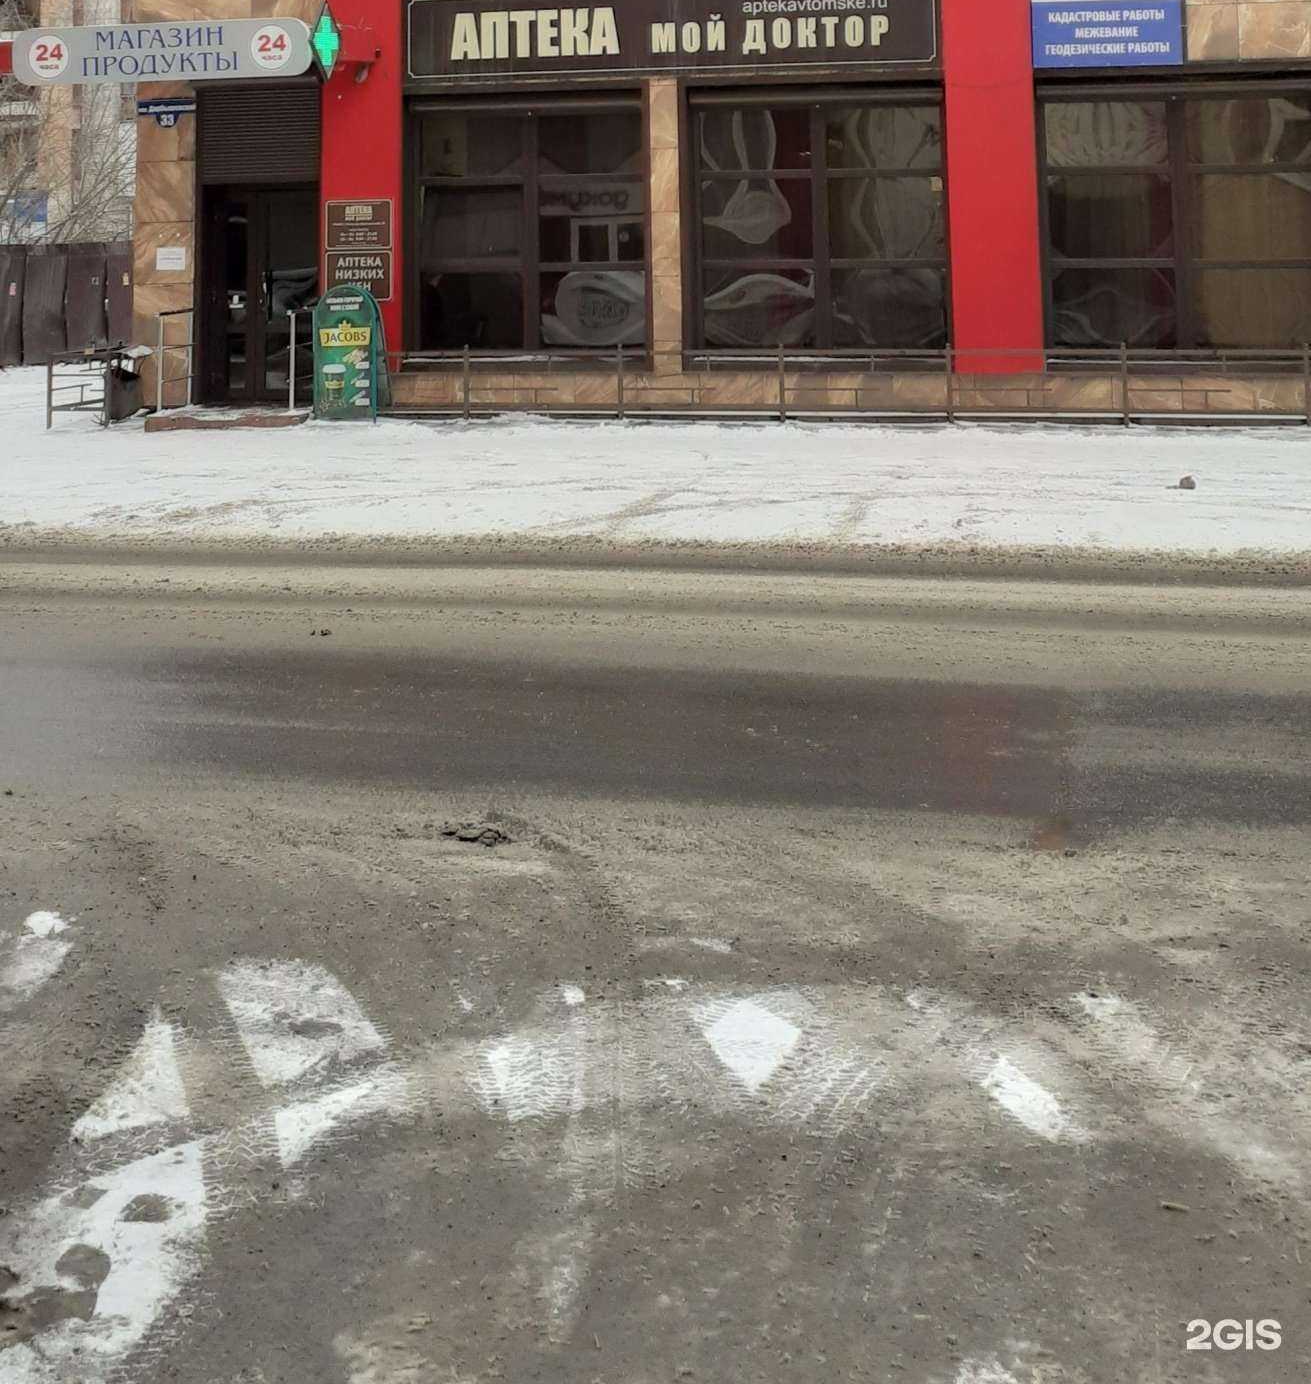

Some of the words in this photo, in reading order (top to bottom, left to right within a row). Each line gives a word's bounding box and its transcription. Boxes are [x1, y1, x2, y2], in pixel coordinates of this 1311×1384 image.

[1048, 10, 1121, 24] КАДАСТРОВЫЕ
[1123, 8, 1165, 21] РАБОТЫ
[95, 26, 224, 51] МАГАЗИН
[450, 7, 621, 61] АПТЕКА
[651, 14, 726, 54] МОЙ
[742, 14, 890, 56] ДОКТОР
[1075, 26, 1139, 39] МЕЖЕВАНИЕ
[257, 33, 287, 53] 24
[1045, 43, 1126, 57] ГЕОДЕЗИЧЕСКИЕ
[1128, 42, 1170, 54] РАБОТЫ
[35, 43, 63, 62] 24
[82, 50, 239, 77] ПРОДУКТЫ
[160, 114, 175, 126] 33
[337, 256, 382, 267] АПТЕКА
[336, 268, 384, 280] НИЗКИХ
[324, 331, 367, 344] JACOBS
